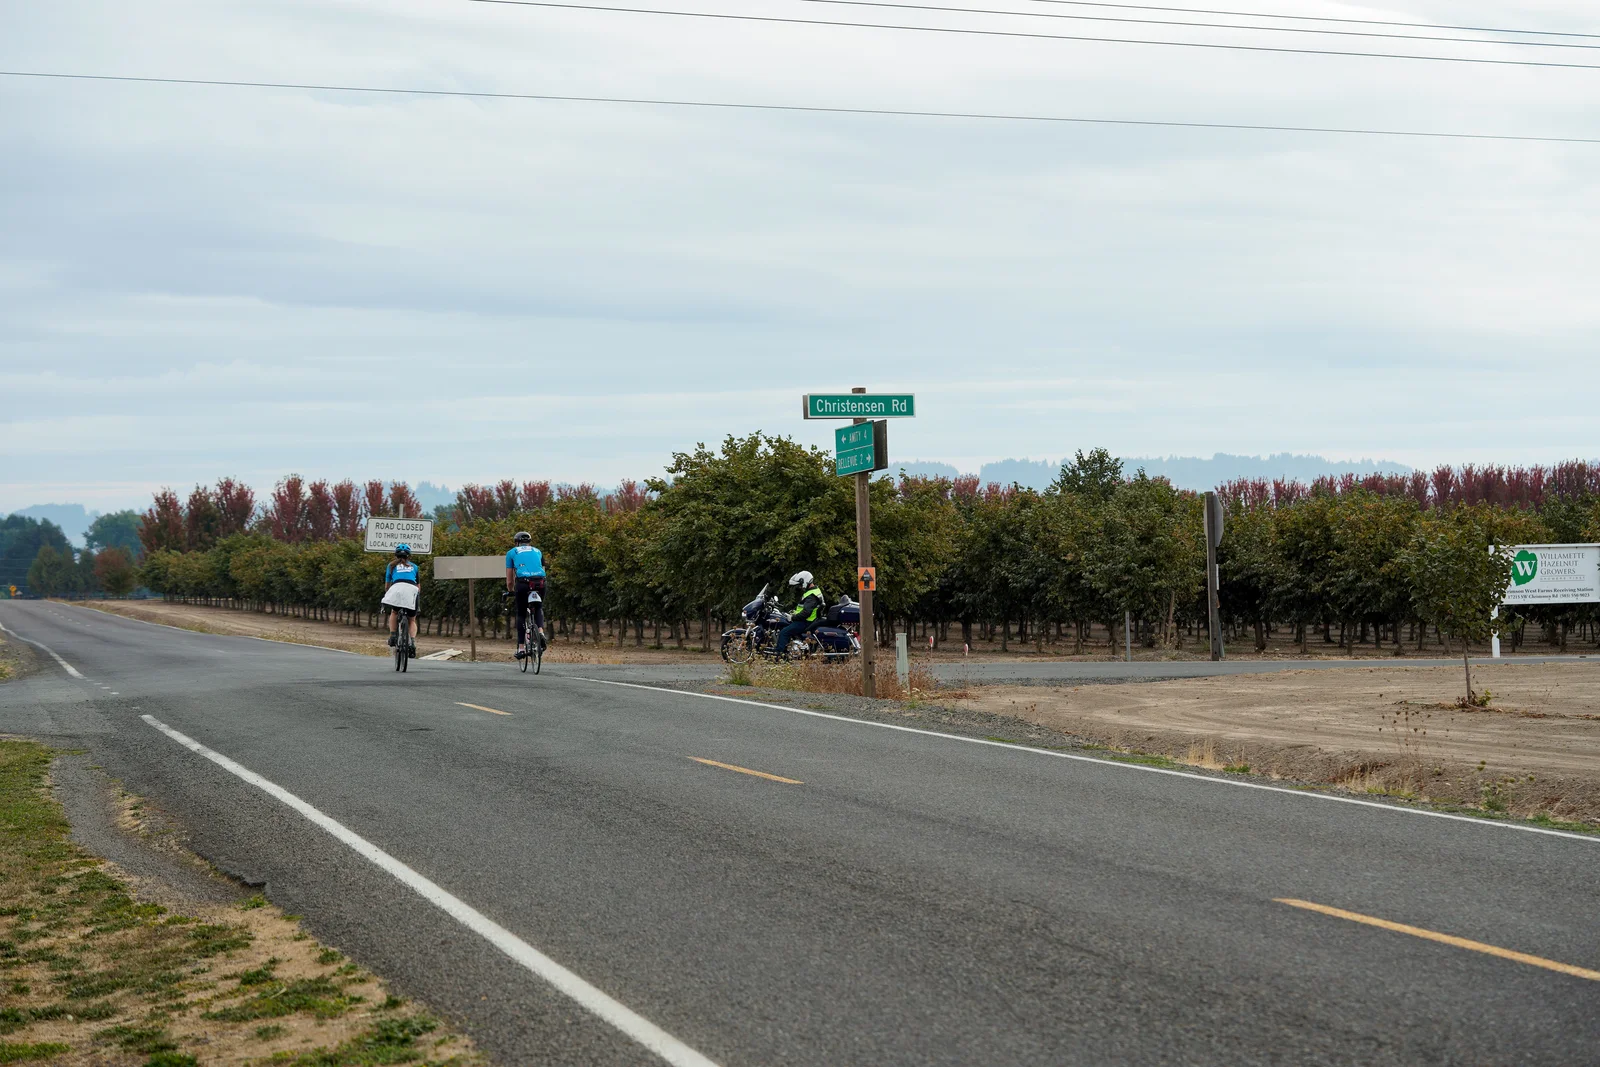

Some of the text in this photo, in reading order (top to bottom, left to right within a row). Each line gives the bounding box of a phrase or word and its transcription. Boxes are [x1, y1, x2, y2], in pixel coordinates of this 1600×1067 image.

[816, 399, 907, 413] Christensen Rd
[838, 454, 863, 470] BELLEVUE 2
[375, 522, 424, 532] ROAD CLOSED
[1514, 560, 1536, 576] W
